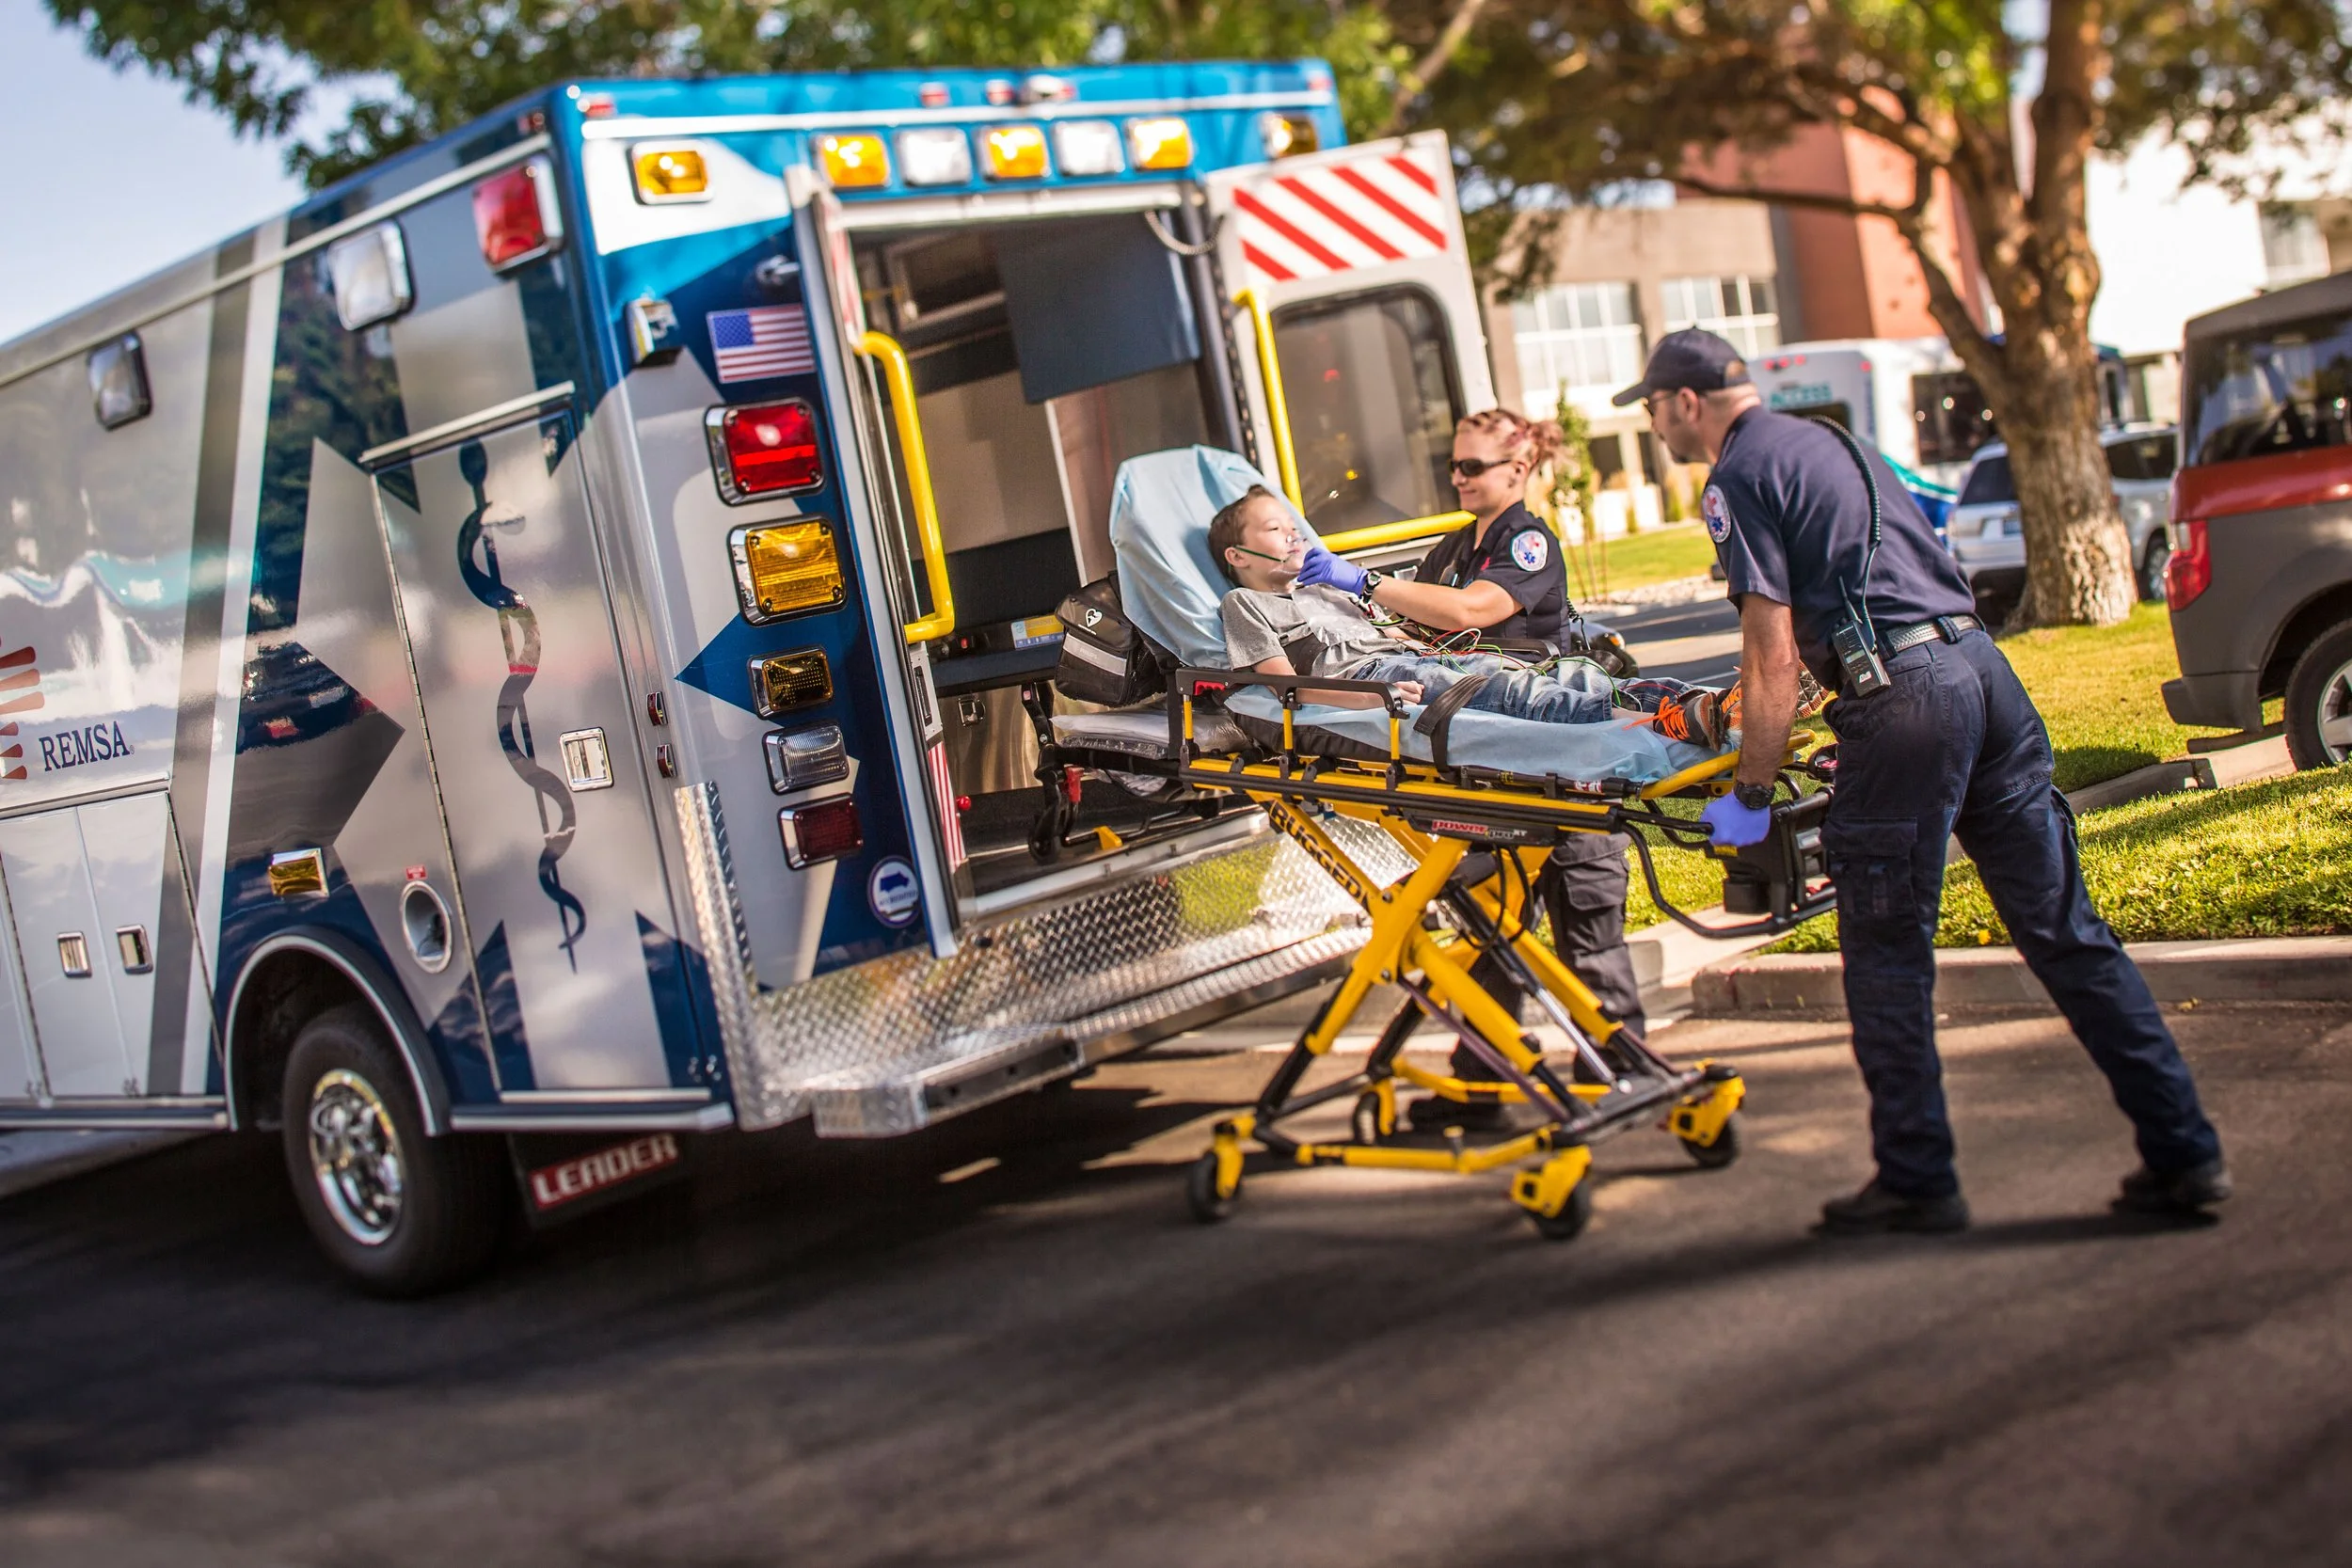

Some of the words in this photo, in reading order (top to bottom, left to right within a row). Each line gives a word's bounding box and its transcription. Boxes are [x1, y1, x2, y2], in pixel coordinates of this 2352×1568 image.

[39, 721, 130, 771] REMSA
[1270, 801, 1362, 900] RUGGED
[533, 1132, 679, 1204] LEADER
